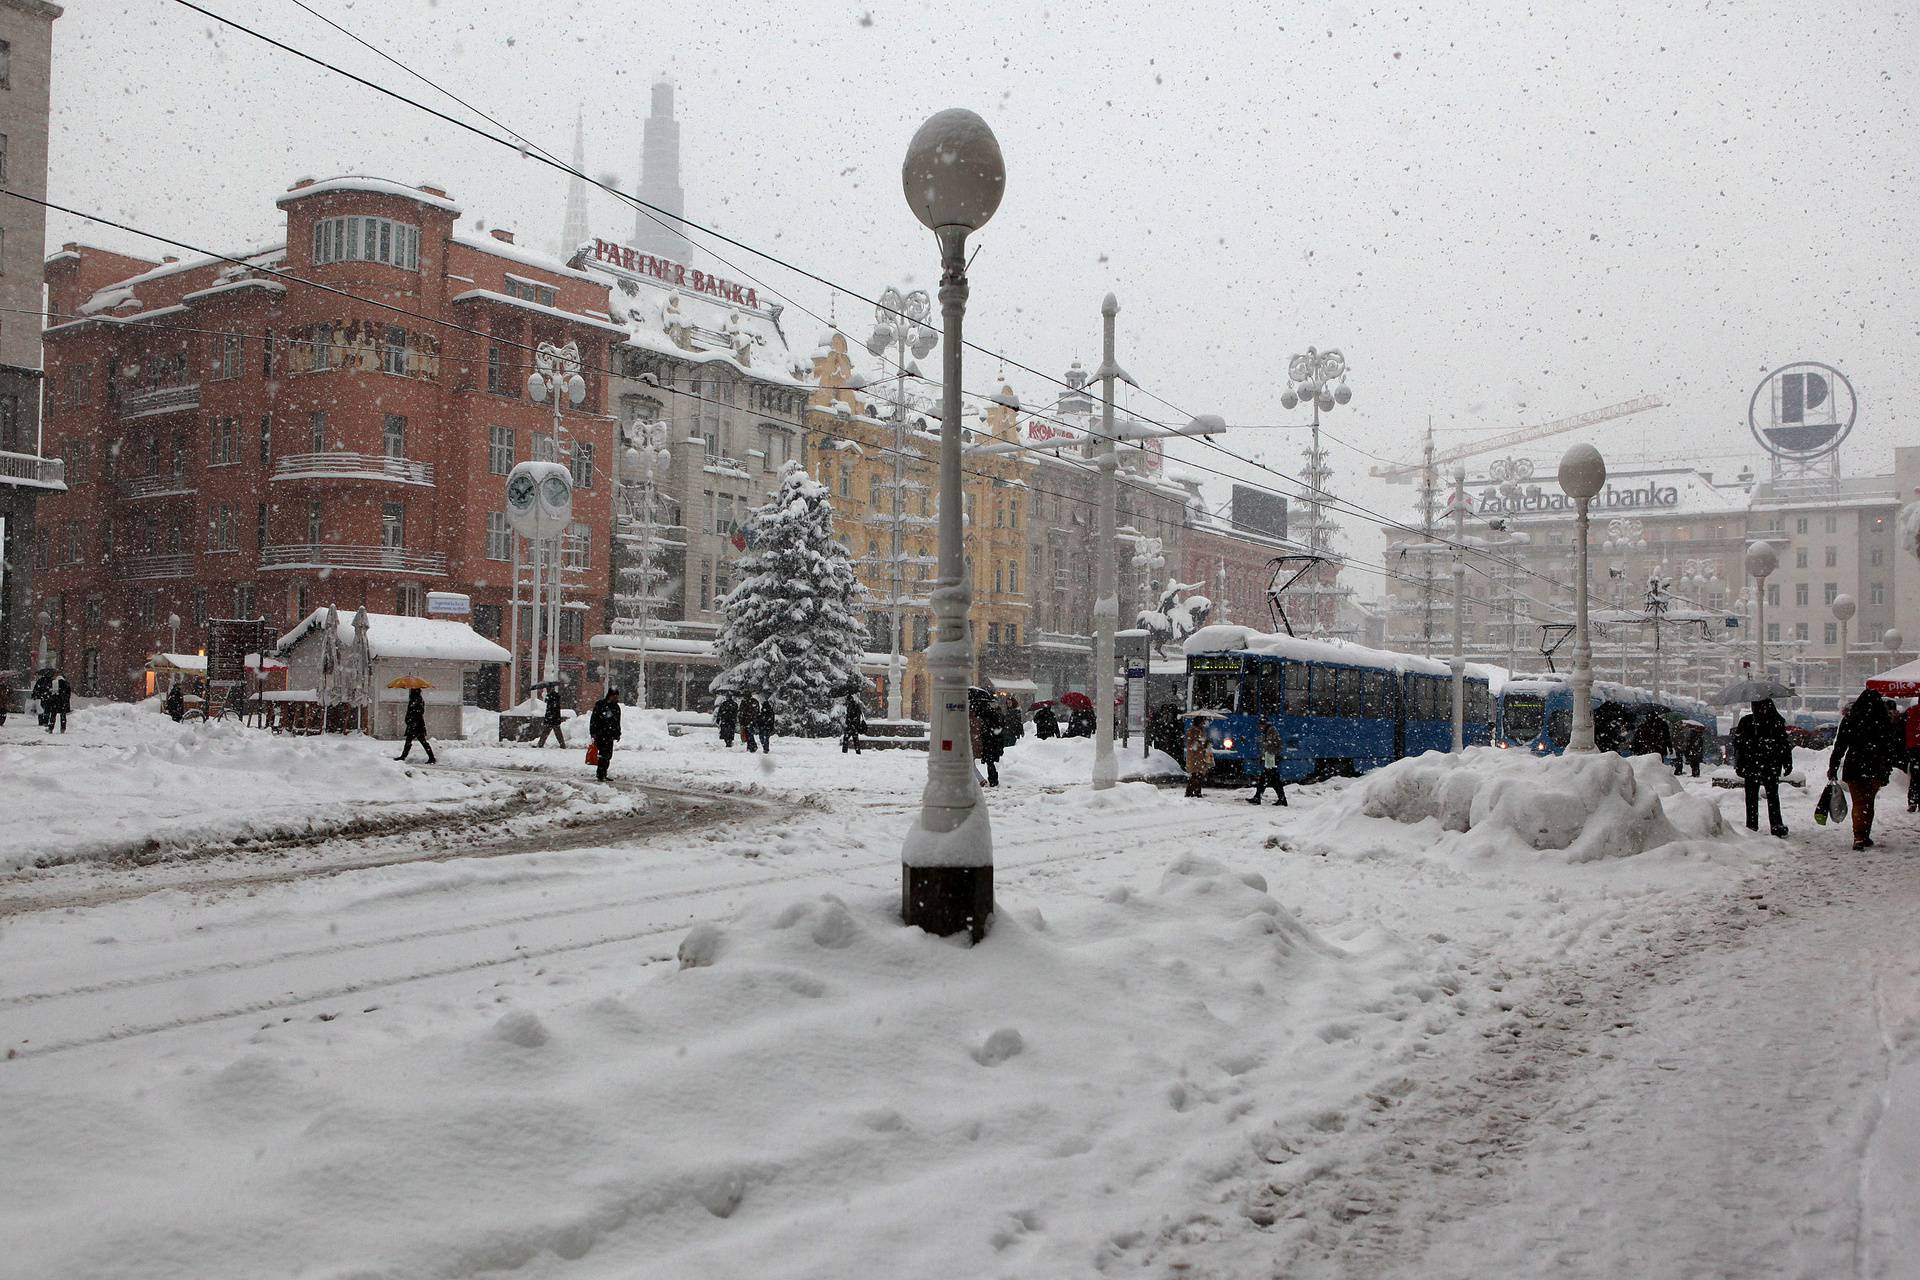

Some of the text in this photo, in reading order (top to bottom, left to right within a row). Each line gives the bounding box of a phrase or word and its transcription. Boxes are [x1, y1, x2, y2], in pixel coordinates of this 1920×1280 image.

[595, 239, 759, 310] PARTNER BANKA
[1478, 480, 1679, 513] Zagrebaa banka
